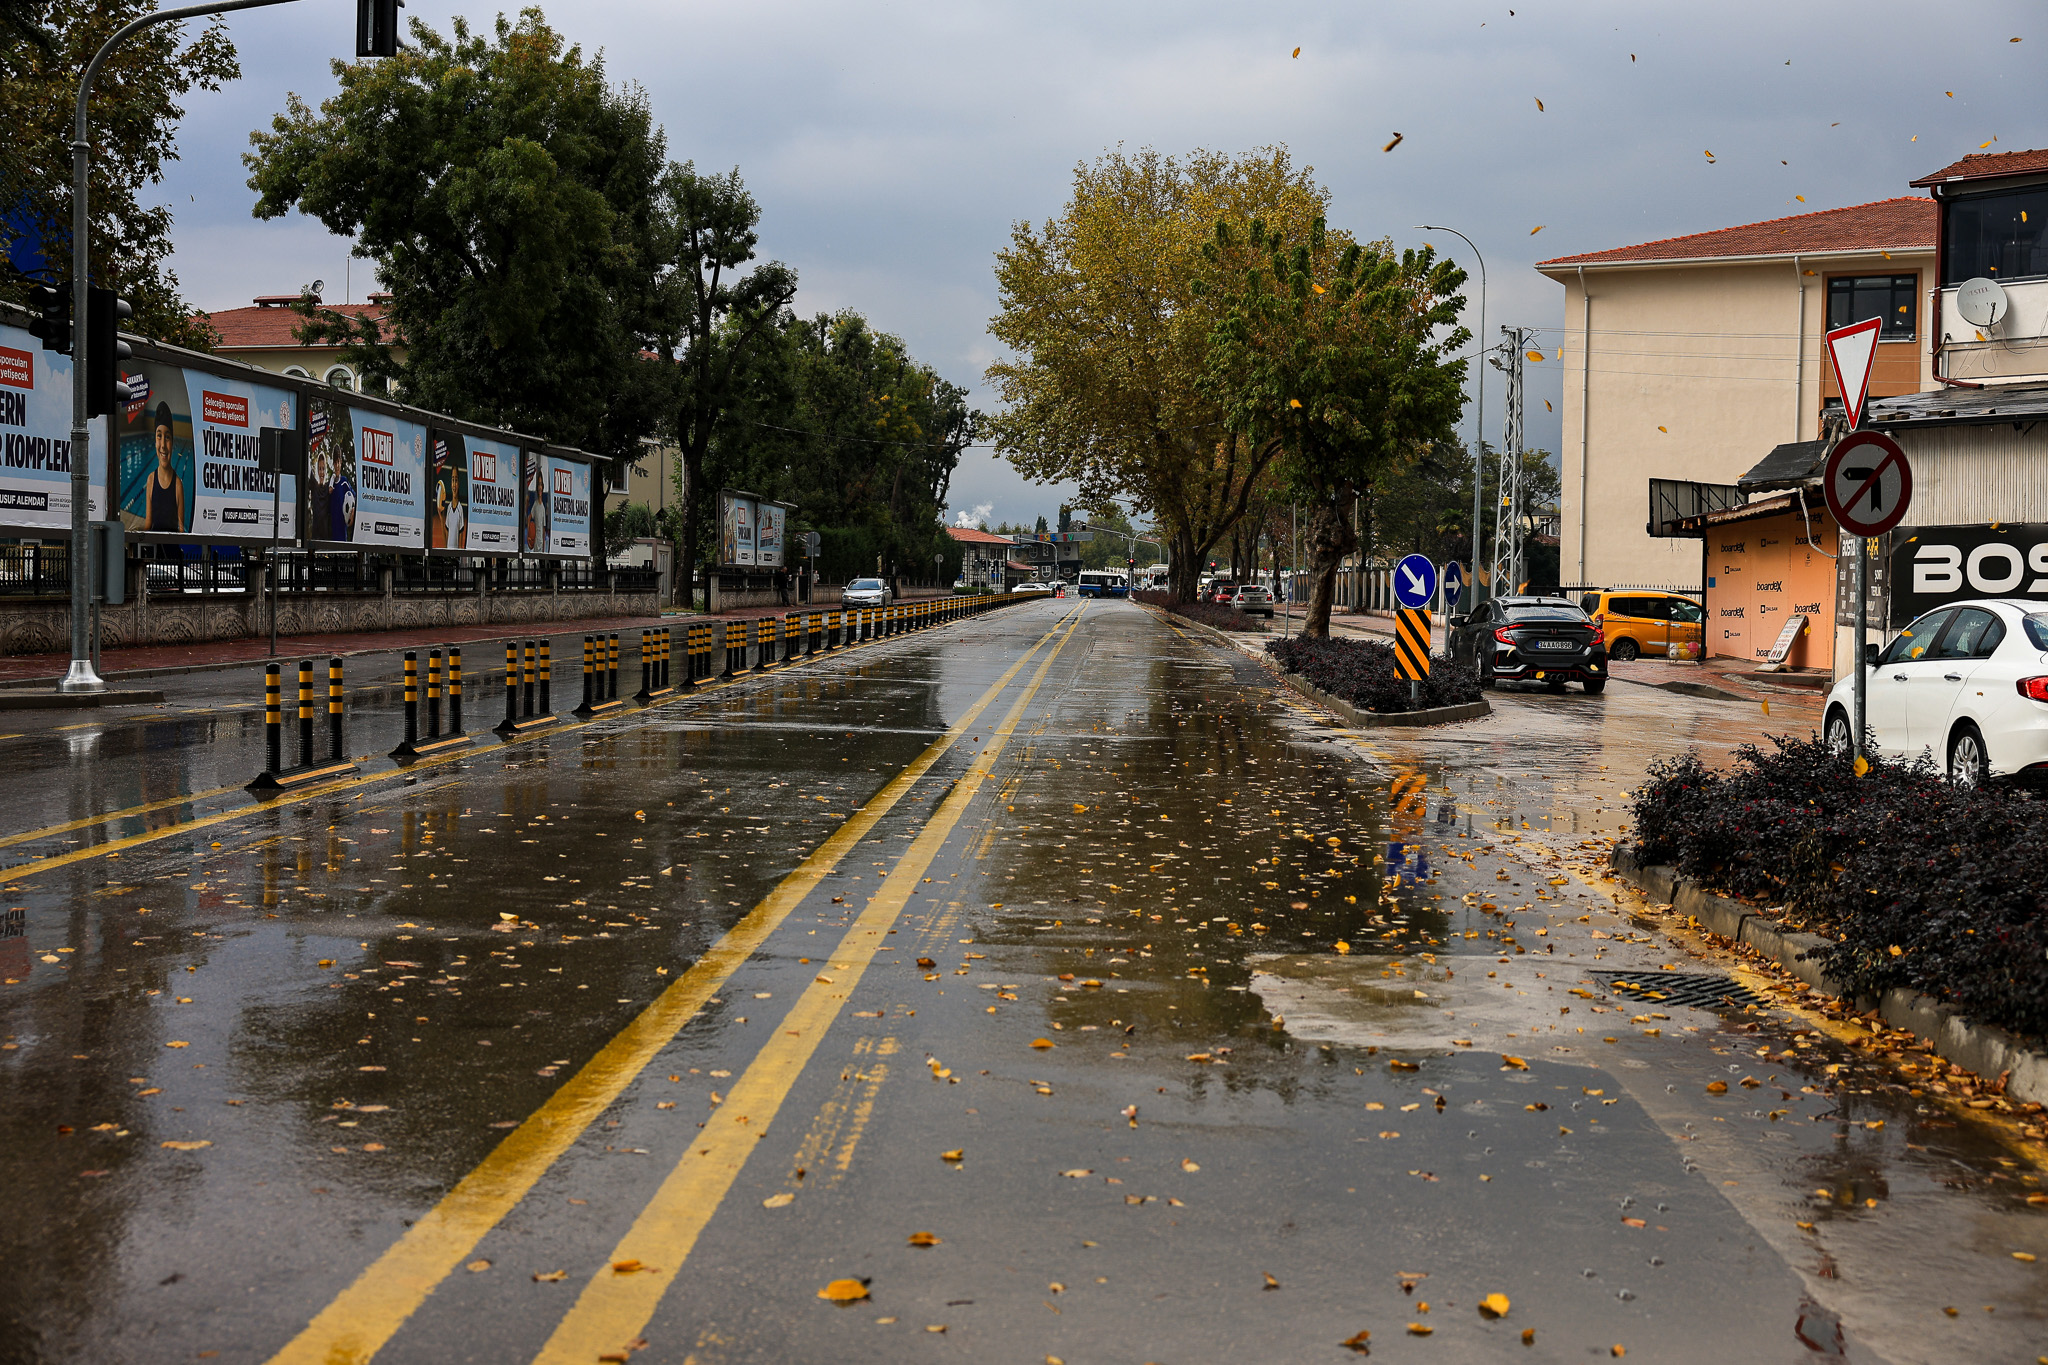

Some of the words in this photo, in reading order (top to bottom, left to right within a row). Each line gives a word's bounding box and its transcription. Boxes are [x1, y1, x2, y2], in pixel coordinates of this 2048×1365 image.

[1966, 287, 1990, 296] VESTEL
[0, 368, 29, 382] yetişecek
[5, 433, 72, 473] KOMPLEK
[203, 426, 234, 459] YÜZME
[235, 434, 260, 461] HAVU
[363, 431, 373, 459] 10
[203, 462, 241, 494] GENÇLİK
[474, 454, 480, 478] 10
[362, 465, 387, 491] FUTBOL
[388, 469, 411, 495] SAHASI
[16, 495, 46, 507] ALEMDAR
[472, 484, 498, 506] VOLEYBOL
[498, 487, 514, 508] SAHASI
